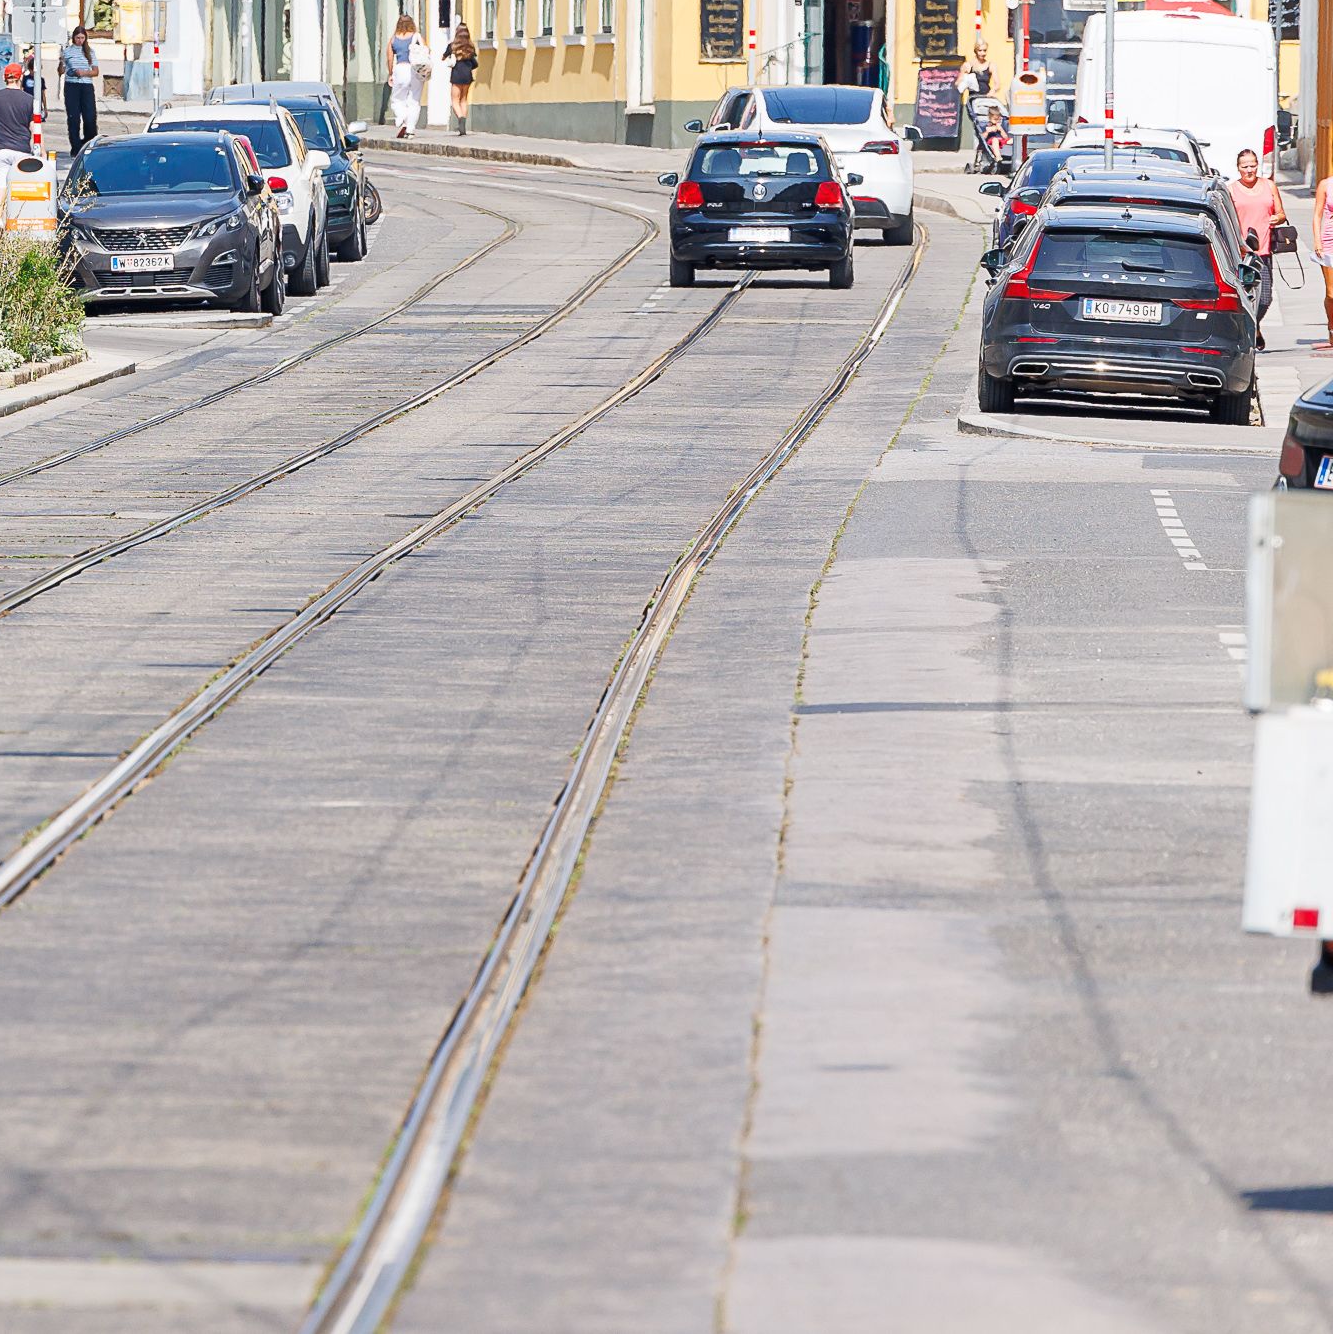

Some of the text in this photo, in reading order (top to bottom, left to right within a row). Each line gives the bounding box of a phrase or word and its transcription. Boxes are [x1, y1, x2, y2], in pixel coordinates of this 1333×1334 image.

[119, 258, 126, 268] W
[1082, 272, 1167, 283] VOLVO
[1094, 302, 1110, 314] KO
